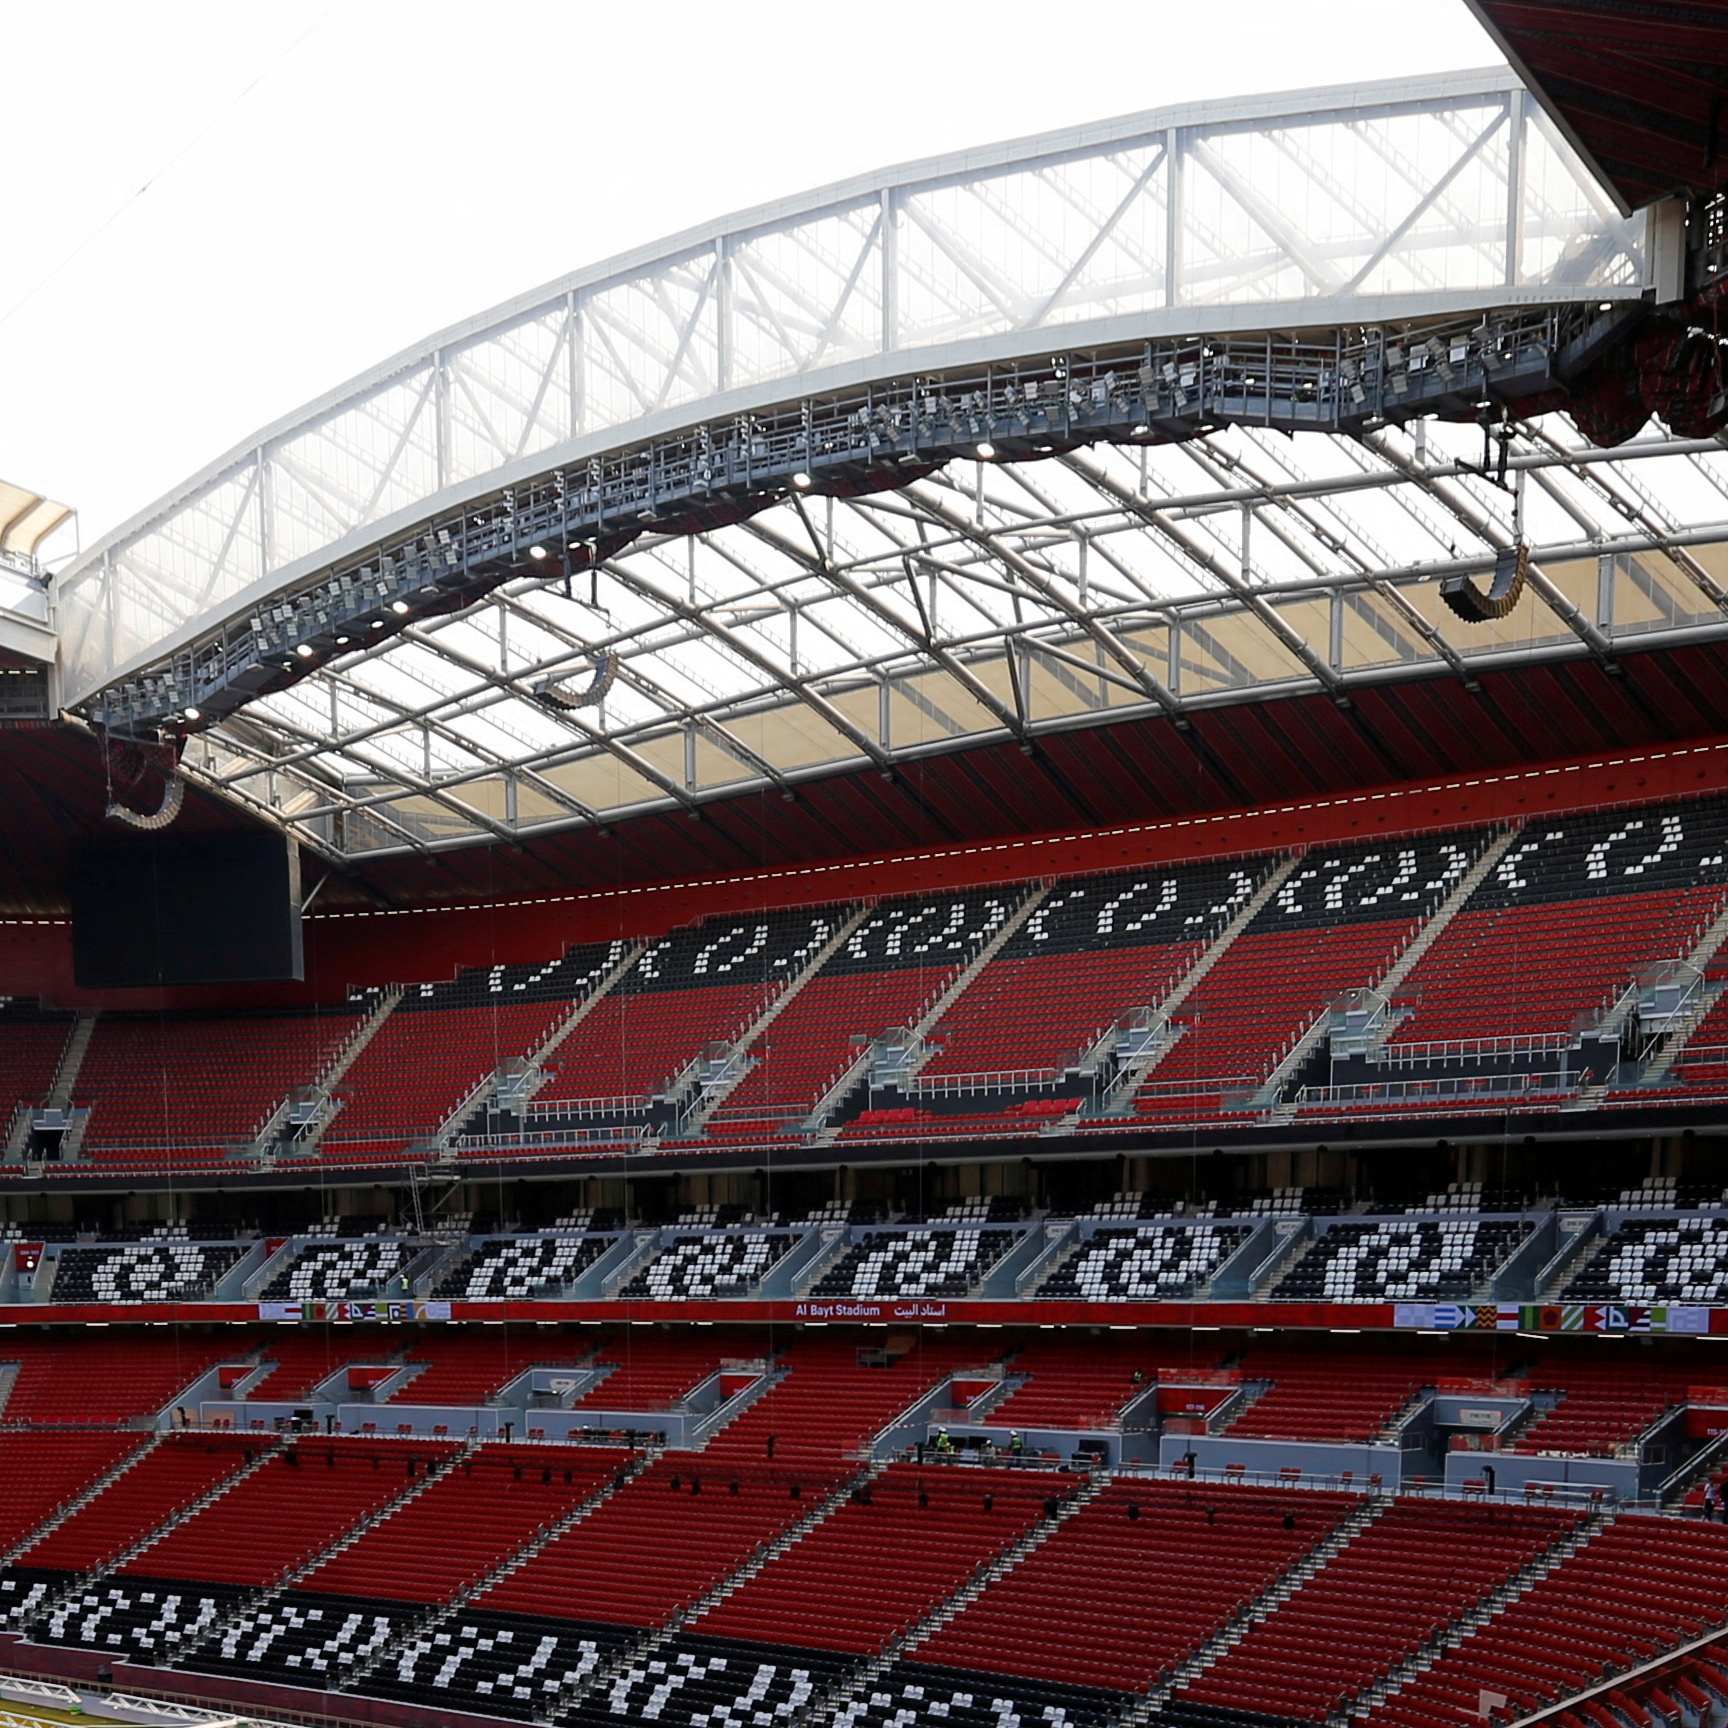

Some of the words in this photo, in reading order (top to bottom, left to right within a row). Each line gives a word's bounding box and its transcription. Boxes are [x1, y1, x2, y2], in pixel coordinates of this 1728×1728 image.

[796, 1304, 807, 1316] Al
[810, 1304, 834, 1318] Bayt
[835, 1304, 881, 1316] Stadium
[894, 1304, 919, 1318] البيت
[922, 1304, 946, 1316] استاد
